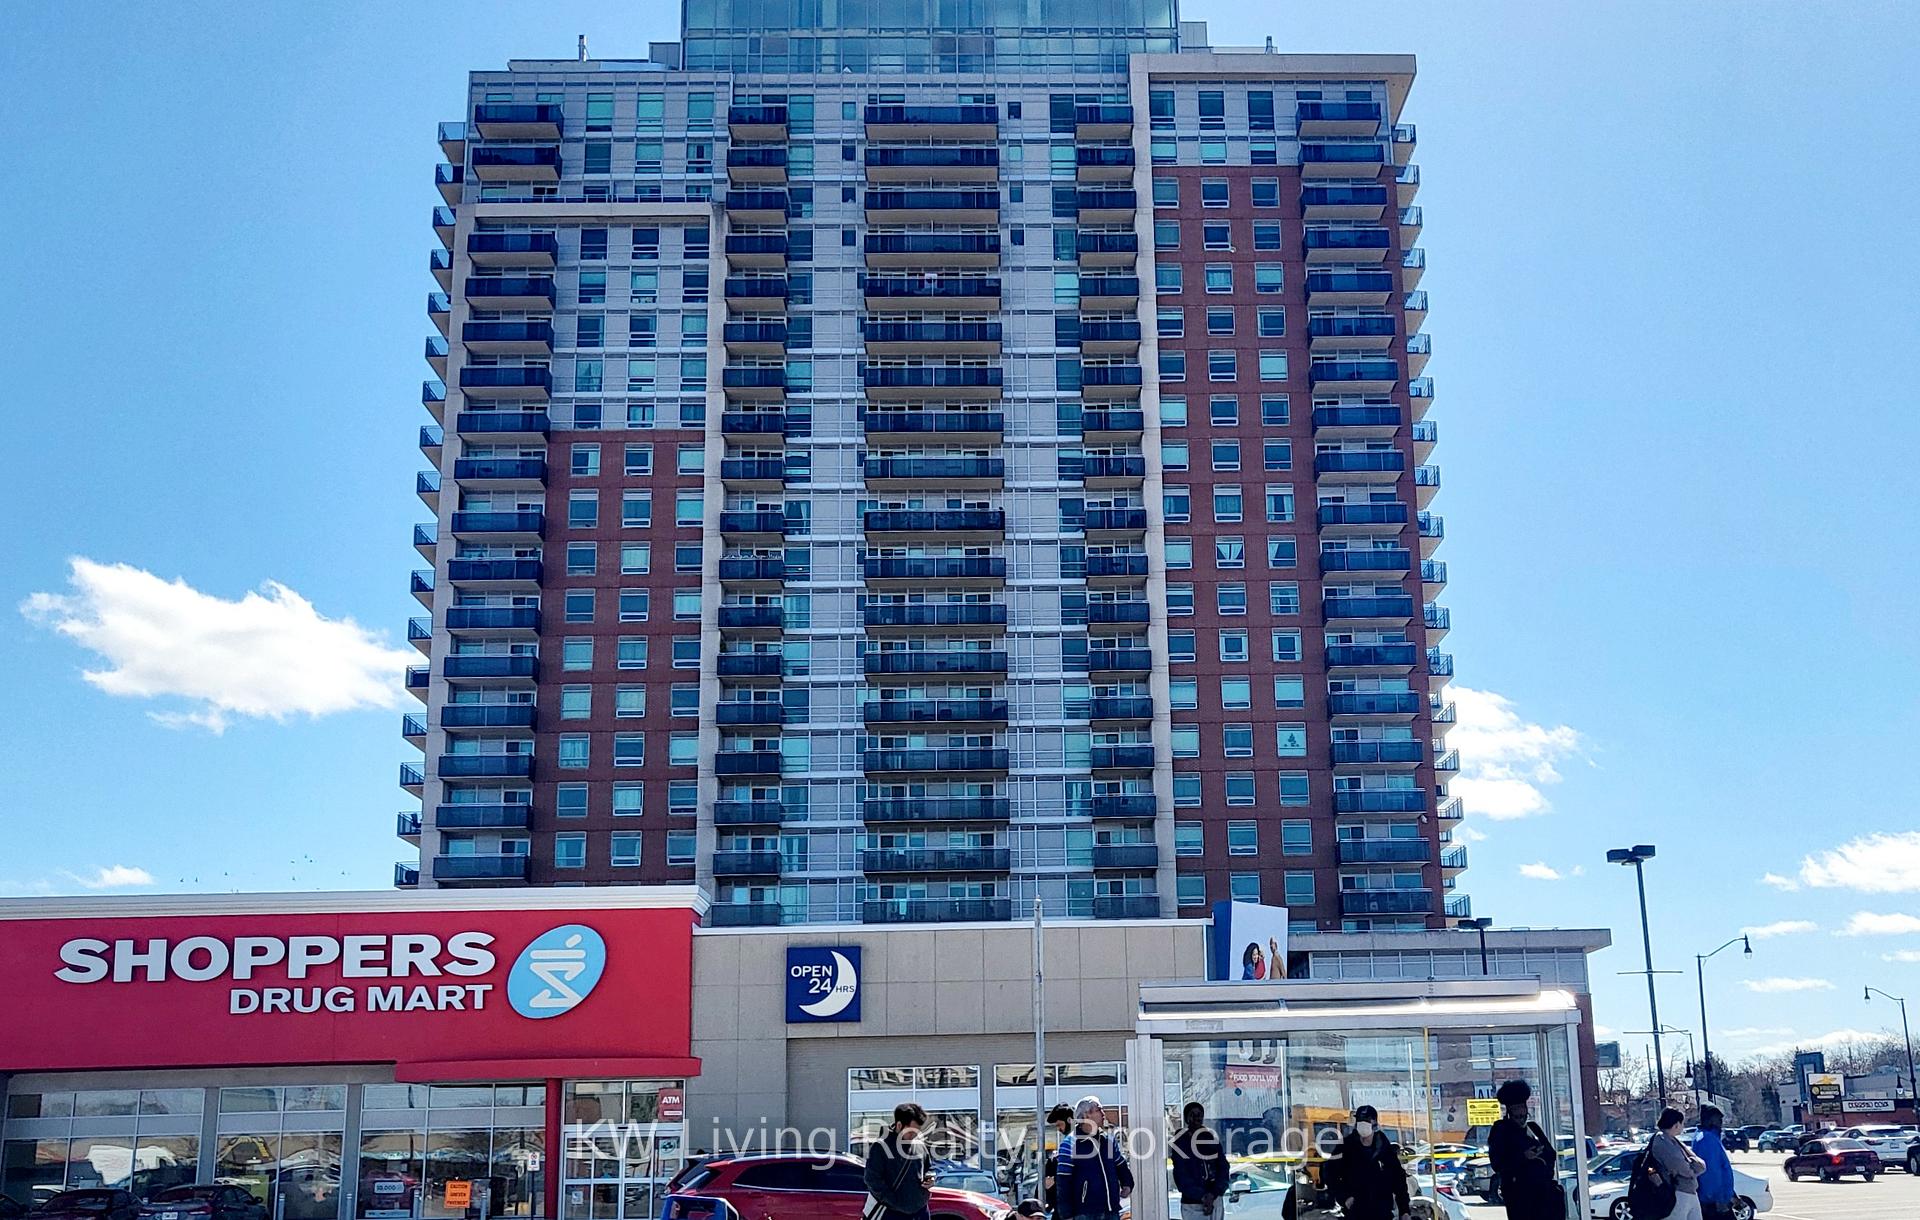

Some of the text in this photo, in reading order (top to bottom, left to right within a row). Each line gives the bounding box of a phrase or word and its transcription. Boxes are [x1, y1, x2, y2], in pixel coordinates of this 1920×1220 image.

[54, 931, 496, 983] SHOPPERS
[791, 966, 832, 977] OPEN
[808, 978, 832, 993] 24
[230, 984, 494, 1014] DRUG MART
[661, 1096, 681, 1104] ATM
